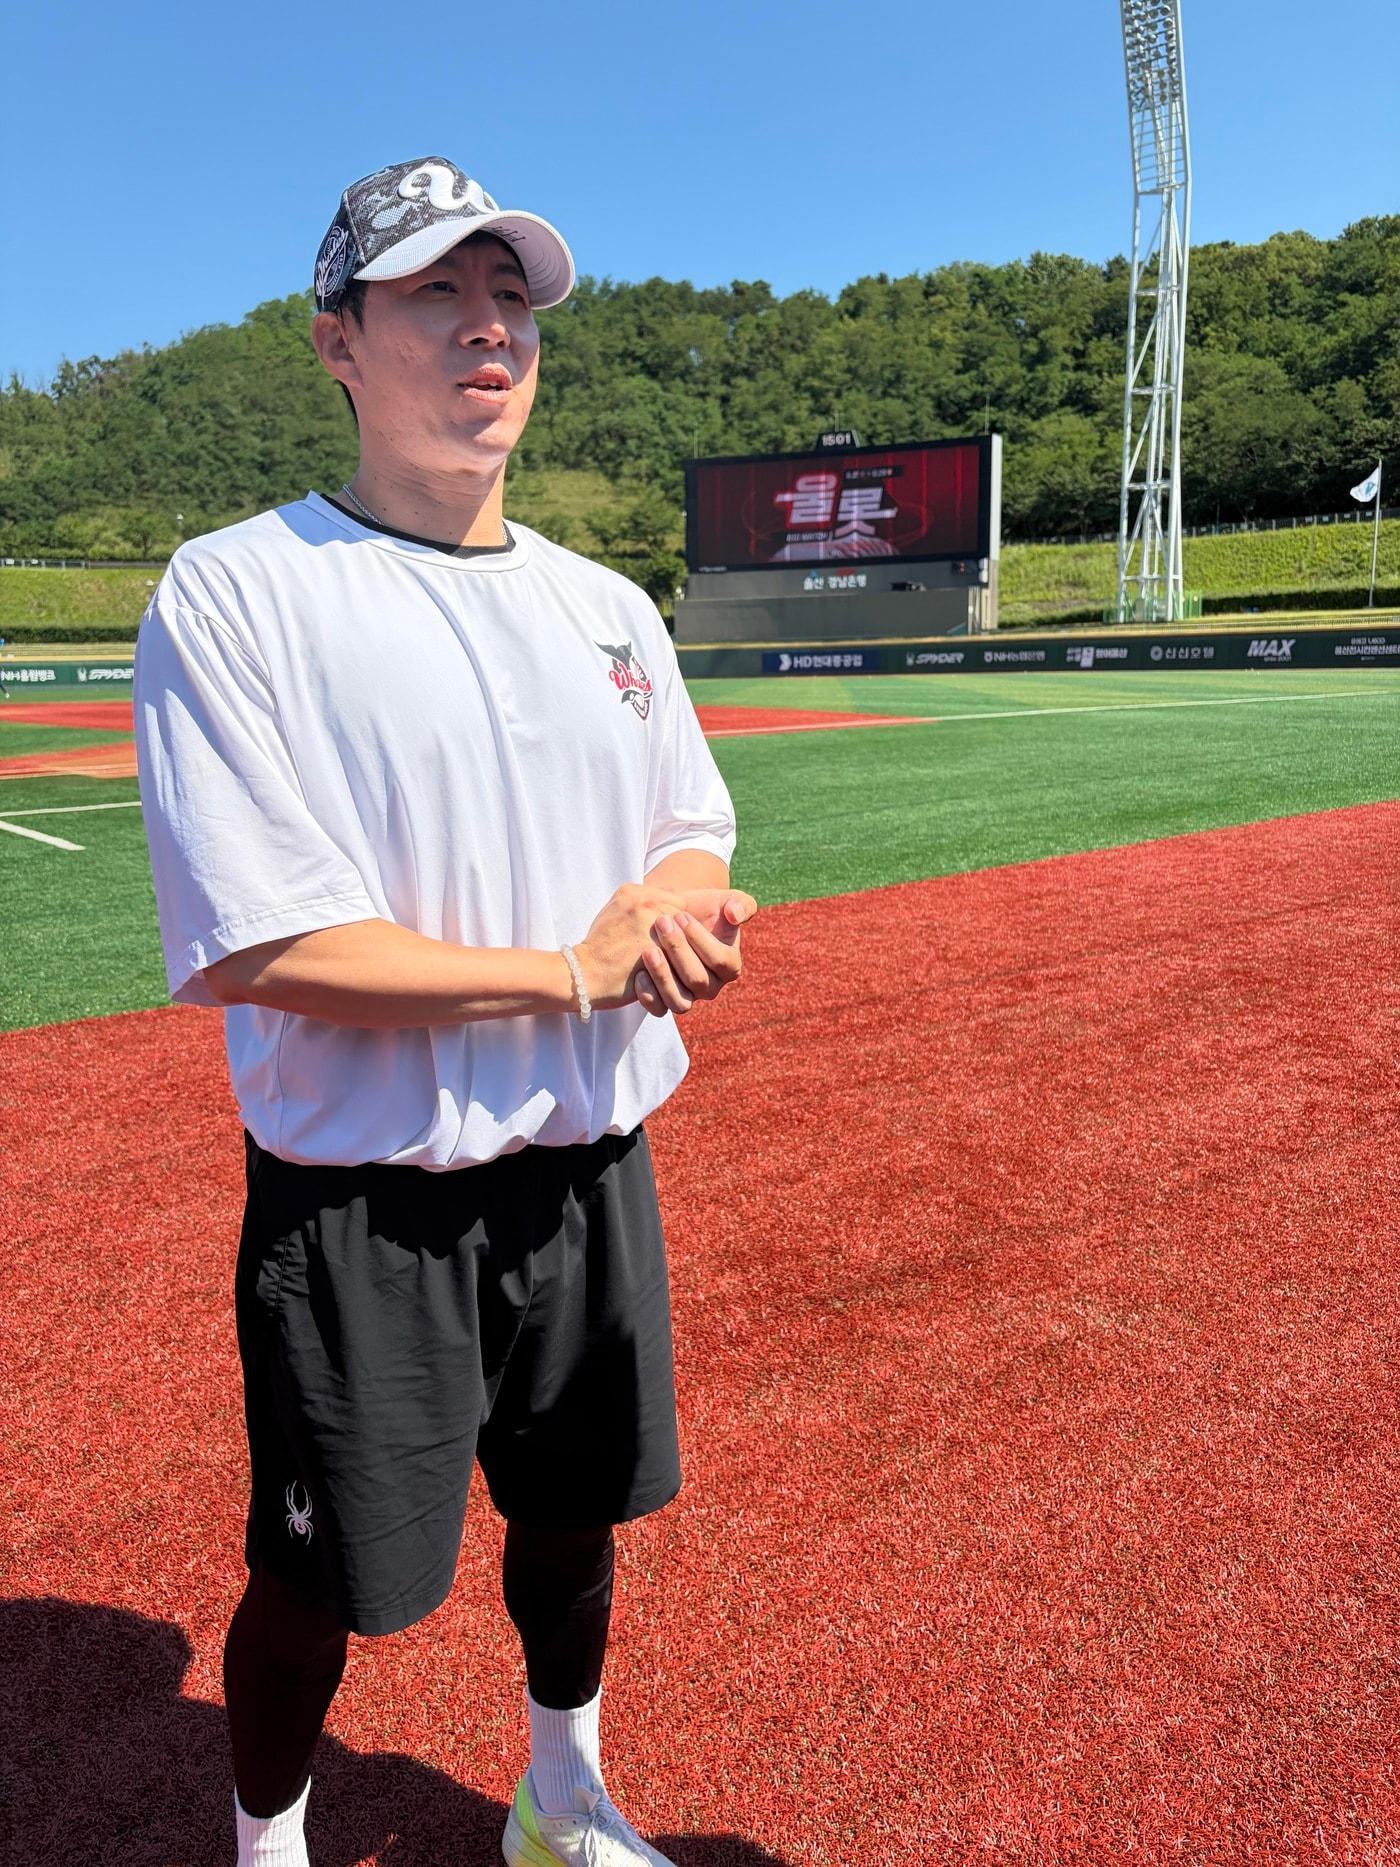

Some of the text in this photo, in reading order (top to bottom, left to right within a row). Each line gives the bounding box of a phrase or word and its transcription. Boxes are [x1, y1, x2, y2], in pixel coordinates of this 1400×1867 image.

[803, 574, 867, 590] 울산 경남은행
[1165, 646, 1214, 659] 신신호텔
[1247, 639, 1297, 657] MAX
[915, 652, 964, 664] SPYDER
